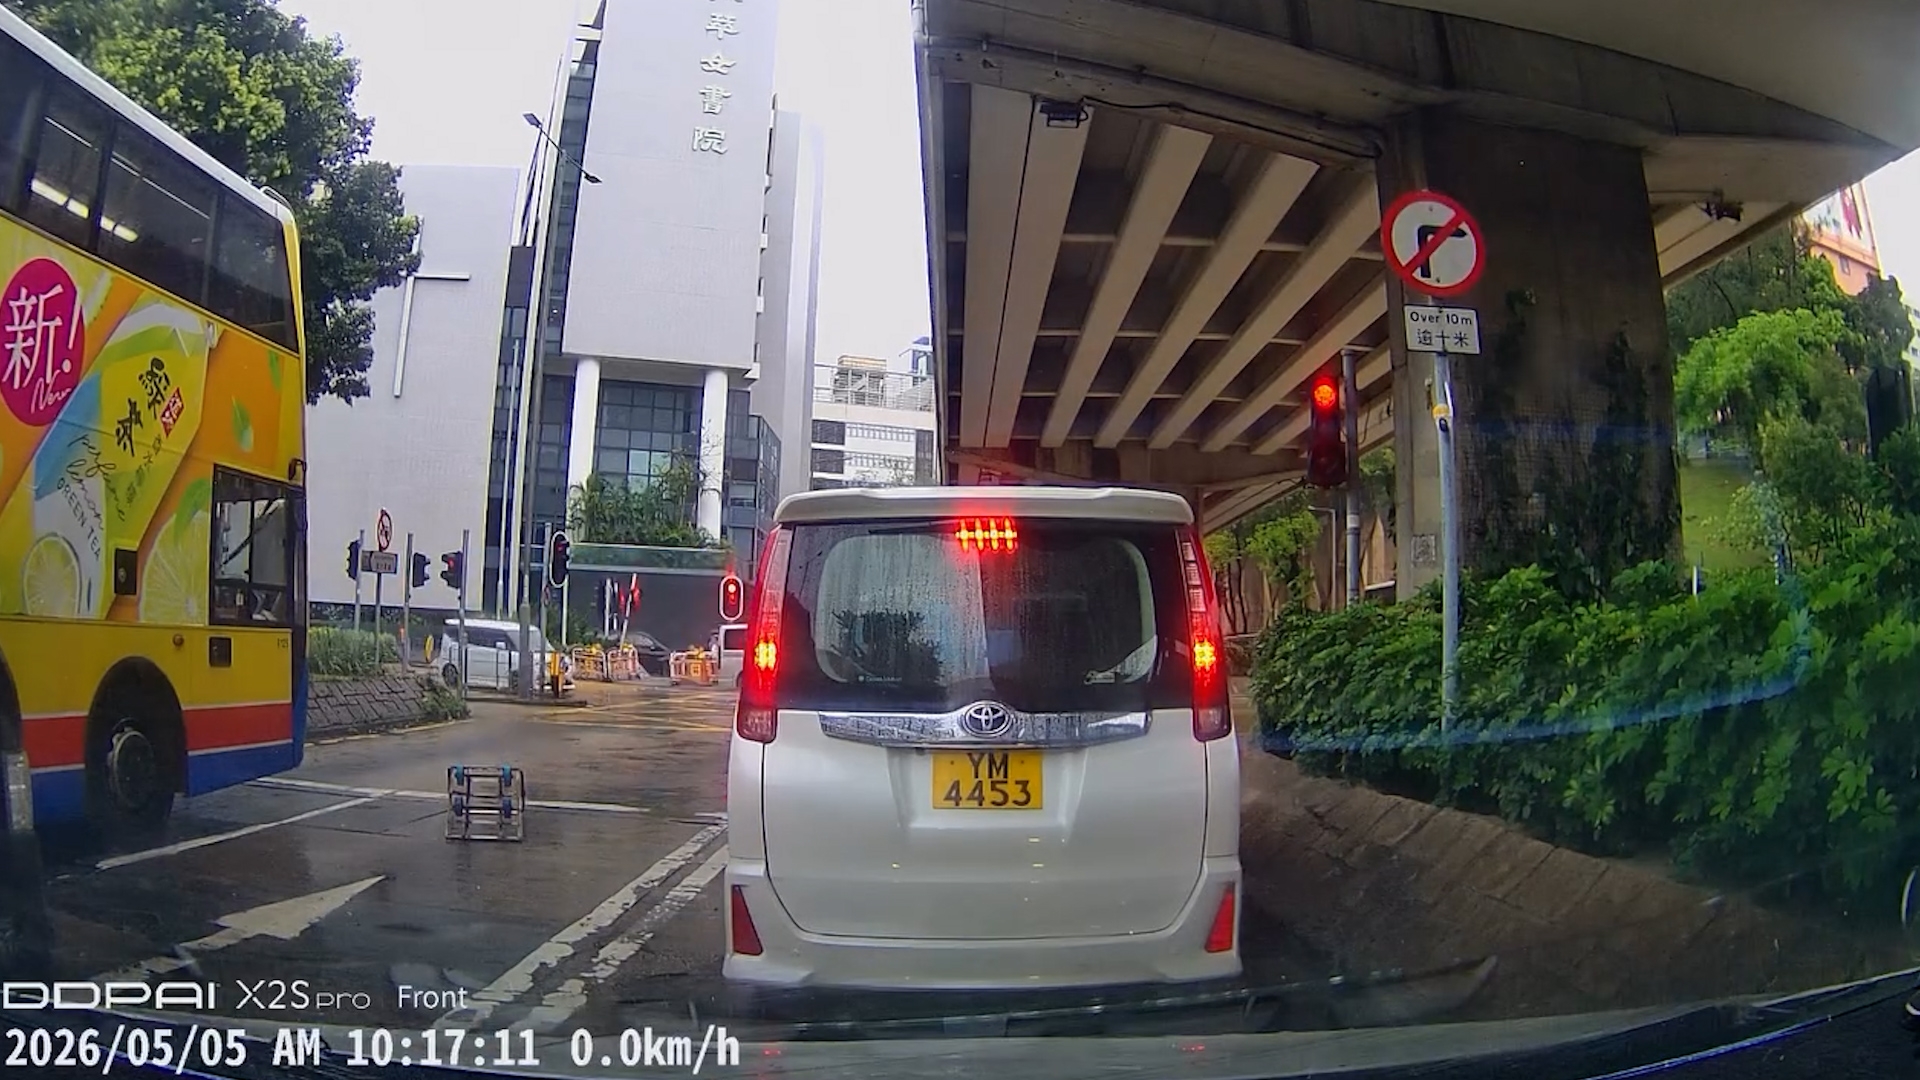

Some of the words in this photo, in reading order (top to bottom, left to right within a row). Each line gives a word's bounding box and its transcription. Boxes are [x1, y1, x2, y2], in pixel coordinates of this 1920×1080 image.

[692, 0, 742, 155] 萃女書院
[1410, 311, 1440, 323] Over
[1446, 313, 1472, 325] 10m
[1417, 328, 1469, 348] 逾十米
[30, 369, 72, 414] New
[57, 477, 88, 528] GREEN
[87, 525, 102, 561] TEA
[967, 752, 1009, 779] YM
[943, 780, 1032, 807] 4453
